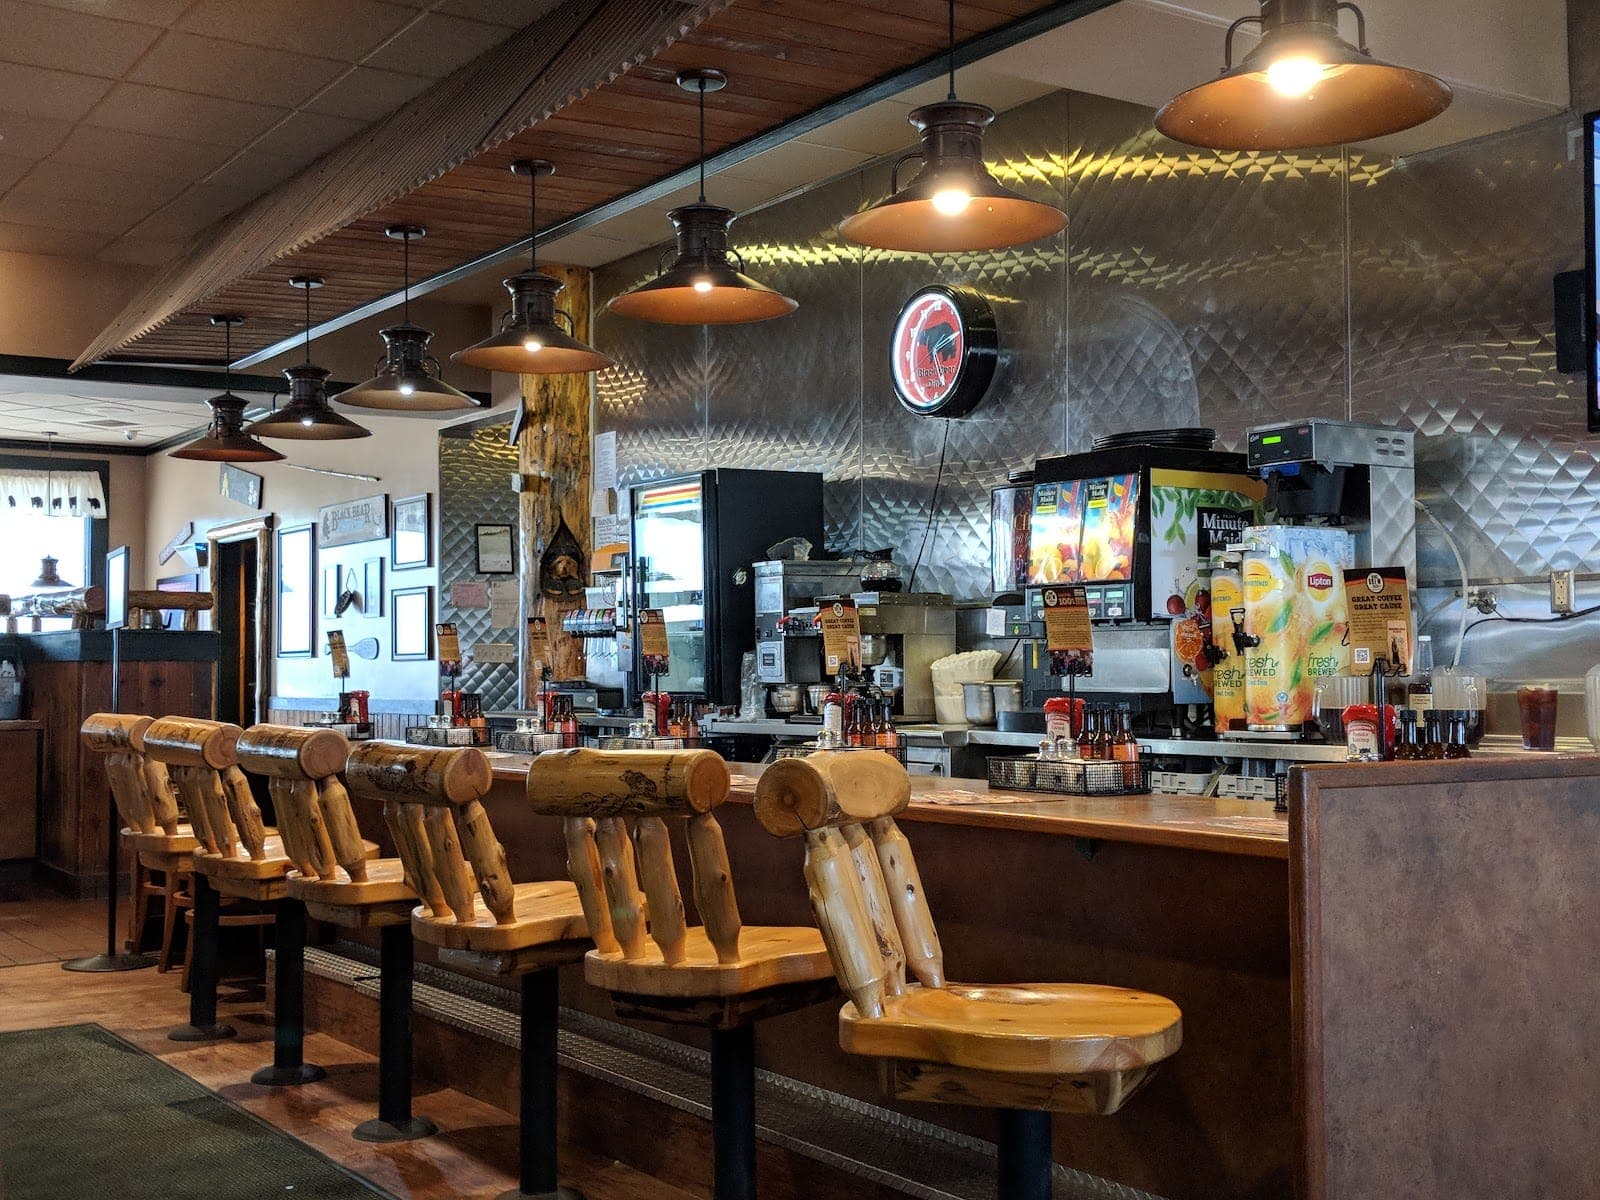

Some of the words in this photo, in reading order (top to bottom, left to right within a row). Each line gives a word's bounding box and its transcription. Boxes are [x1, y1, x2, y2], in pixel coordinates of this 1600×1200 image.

[1202, 512, 1249, 530] Minute
[1209, 530, 1242, 544] Maid
[1309, 577, 1331, 586] Lipton
[1377, 594, 1402, 602] COFFEE
[1307, 652, 1337, 667] fresh
[1214, 665, 1242, 680] resh
[1308, 668, 1337, 676] BREWED
